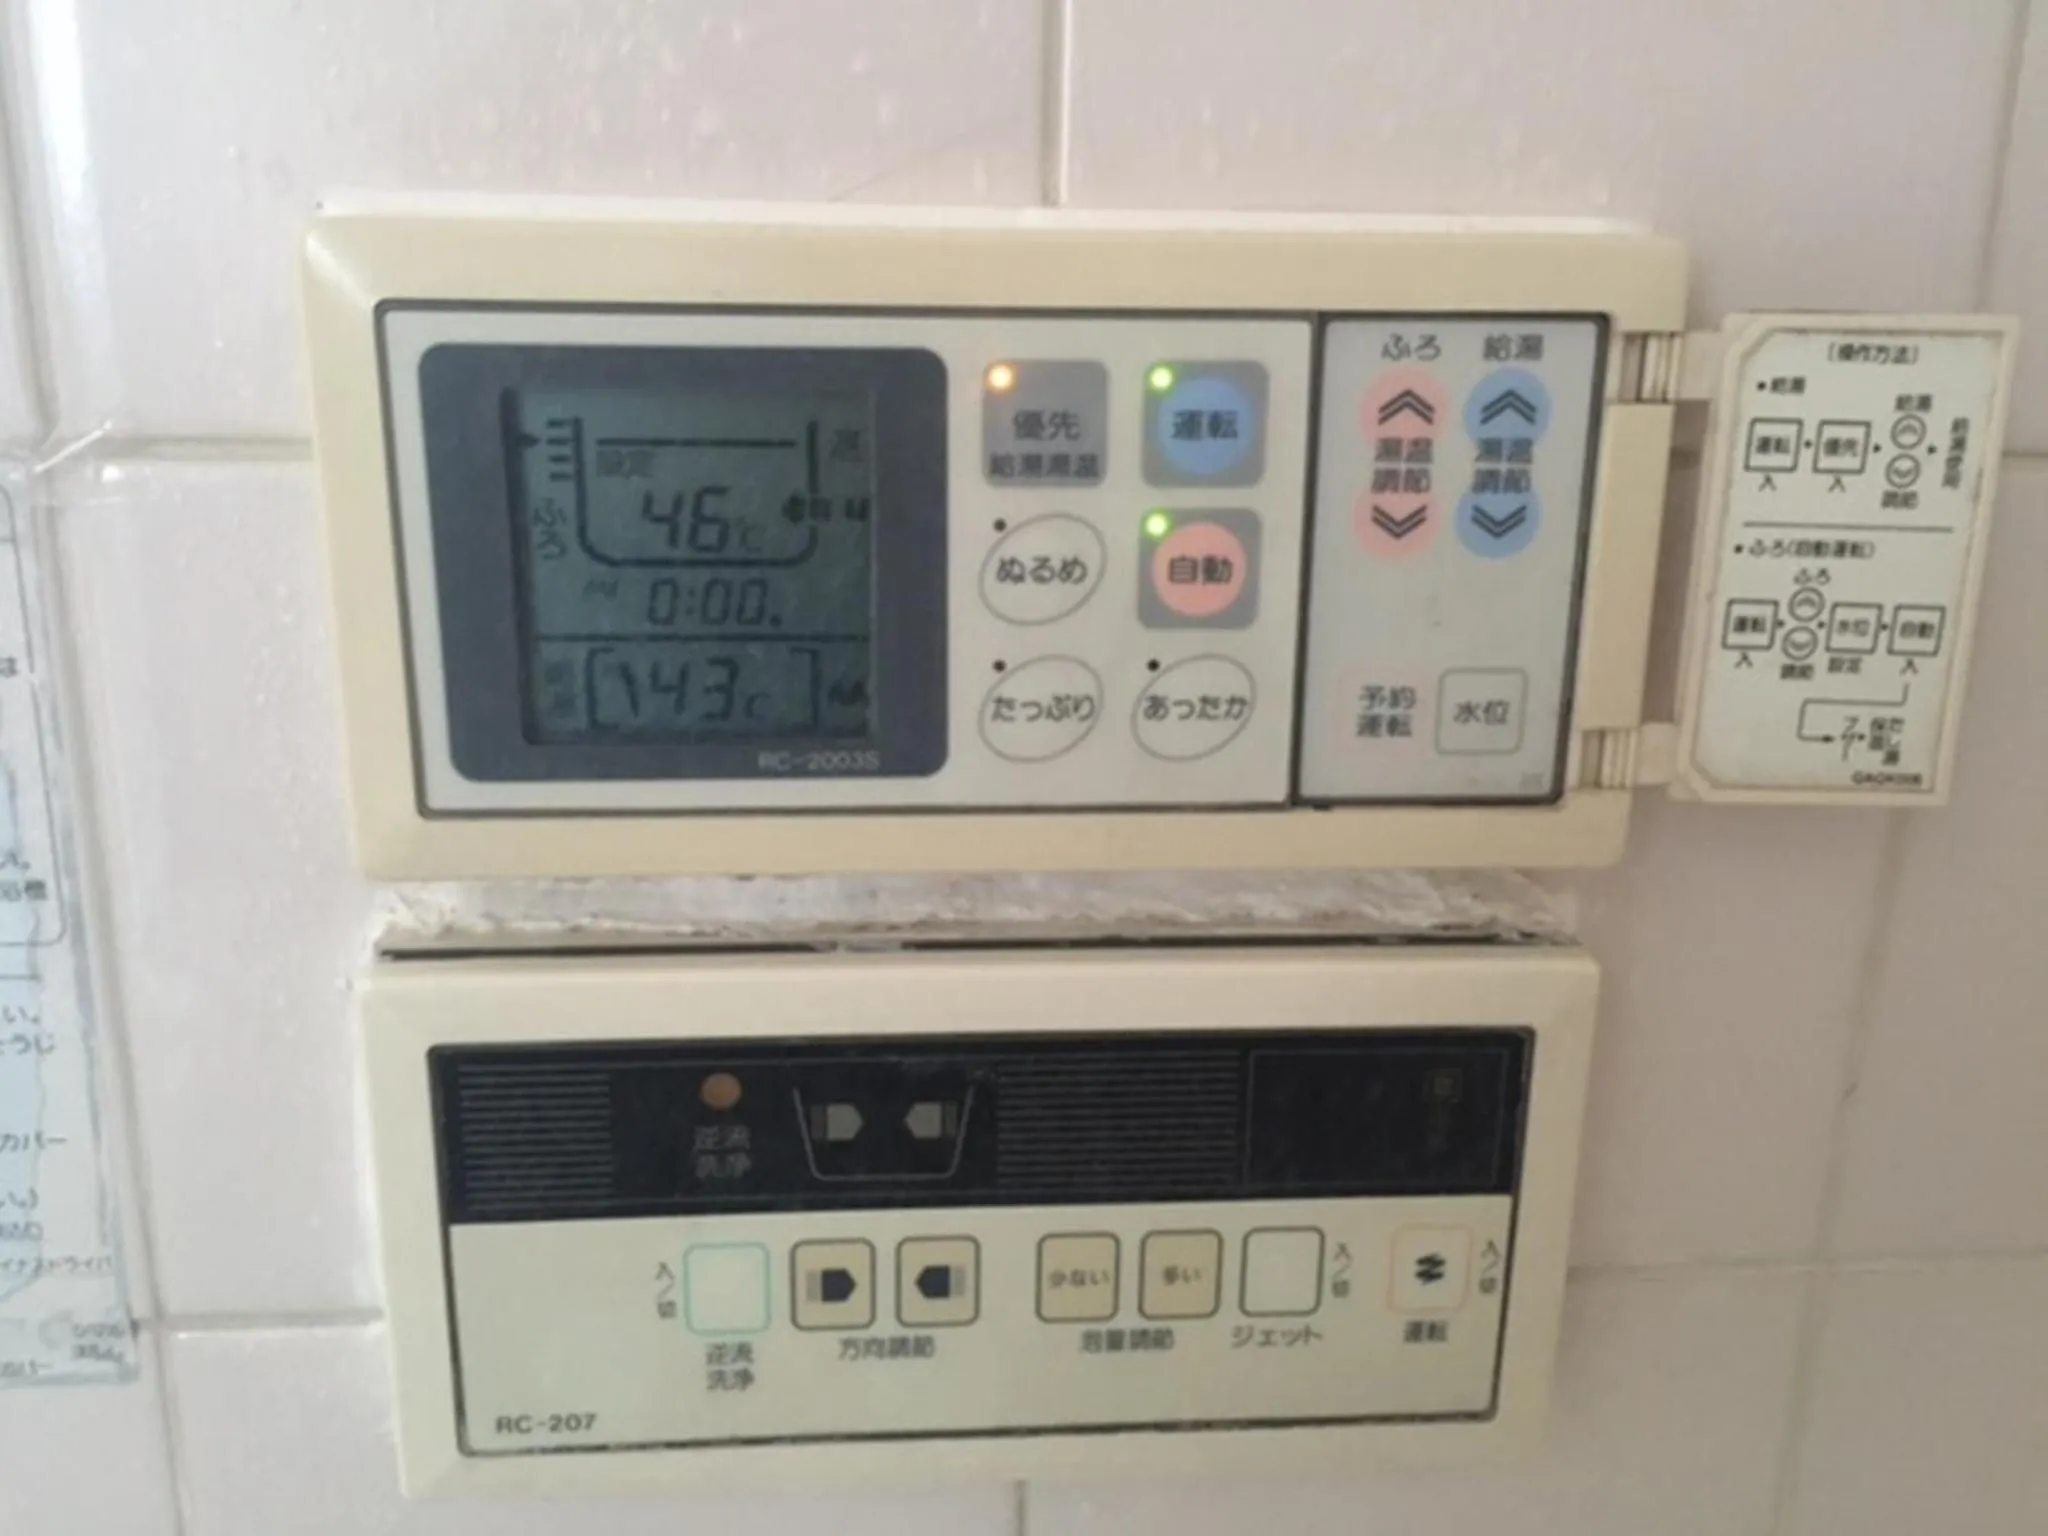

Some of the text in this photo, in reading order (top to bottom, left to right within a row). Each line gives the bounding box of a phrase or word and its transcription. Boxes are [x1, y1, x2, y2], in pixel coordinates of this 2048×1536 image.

[1381, 333, 1441, 361] ふろ
[1483, 333, 1544, 361] 給湯
[1013, 410, 1080, 441] 優先
[1171, 410, 1239, 441] 運転
[997, 556, 1088, 585] ぬるめ
[1168, 555, 1233, 585] 自動
[992, 694, 1096, 723] たっぷり
[1143, 694, 1248, 722] あったか
[1358, 686, 1417, 711] 予約
[1453, 698, 1509, 726] 水位
[1356, 712, 1413, 738] 運転
[758, 751, 880, 771] RC-2003S
[838, 1335, 934, 1360] 方向調節
[1231, 1325, 1324, 1348] ジェット
[496, 1413, 597, 1434] RC-207
